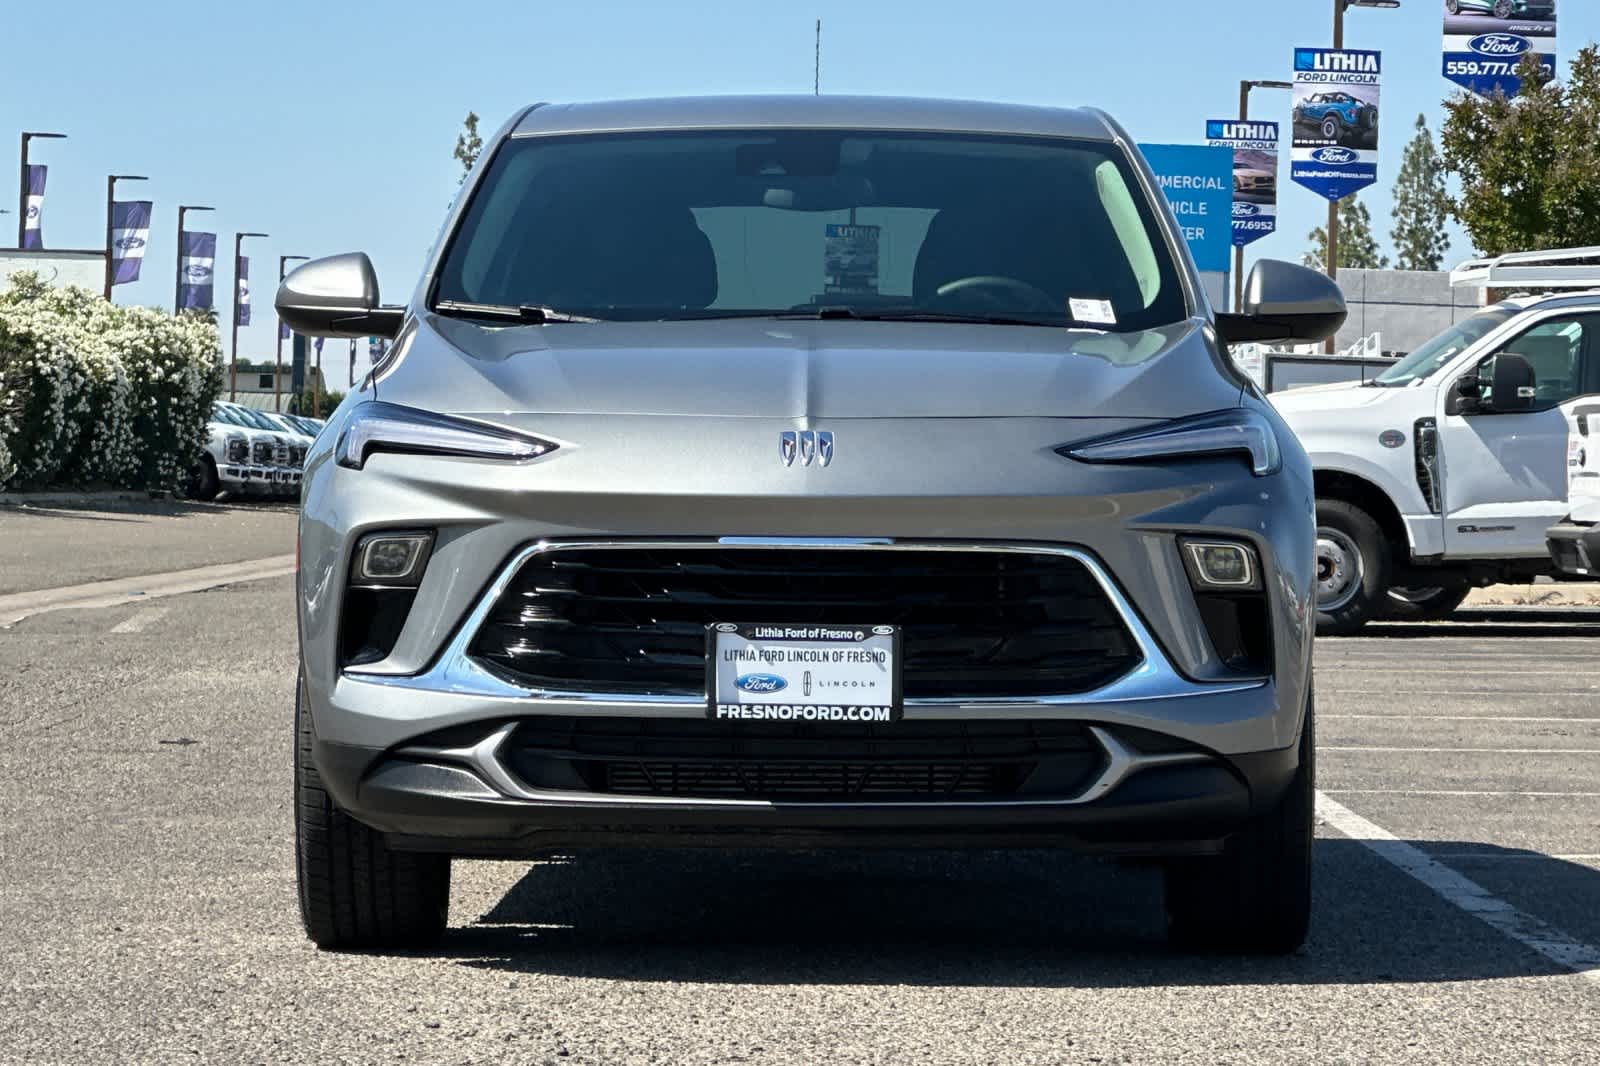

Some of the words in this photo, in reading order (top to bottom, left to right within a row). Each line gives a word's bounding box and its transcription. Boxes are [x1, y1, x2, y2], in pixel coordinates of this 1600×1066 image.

[1480, 36, 1520, 52] Ford
[1314, 52, 1378, 72] LITHIA
[1447, 61, 1552, 76] 559.777.62
[1297, 73, 1328, 81] FORD
[1330, 74, 1377, 83] LINCOLN
[1223, 123, 1276, 140] LITHIA
[1235, 141, 1276, 149] LINCOLN
[1319, 148, 1350, 162] Ford
[755, 627, 783, 638] Lithia
[785, 628, 807, 639] Ford
[808, 629, 819, 639] of
[820, 630, 853, 640] Fresno
[724, 649, 756, 662] LITHIA
[759, 649, 784, 663] FORD
[787, 650, 829, 663] LINCOLN
[832, 651, 844, 663] OF
[847, 651, 886, 664] FRESNO
[744, 676, 777, 690] Ford
[716, 705, 891, 721] FRESNOFORD.COM
